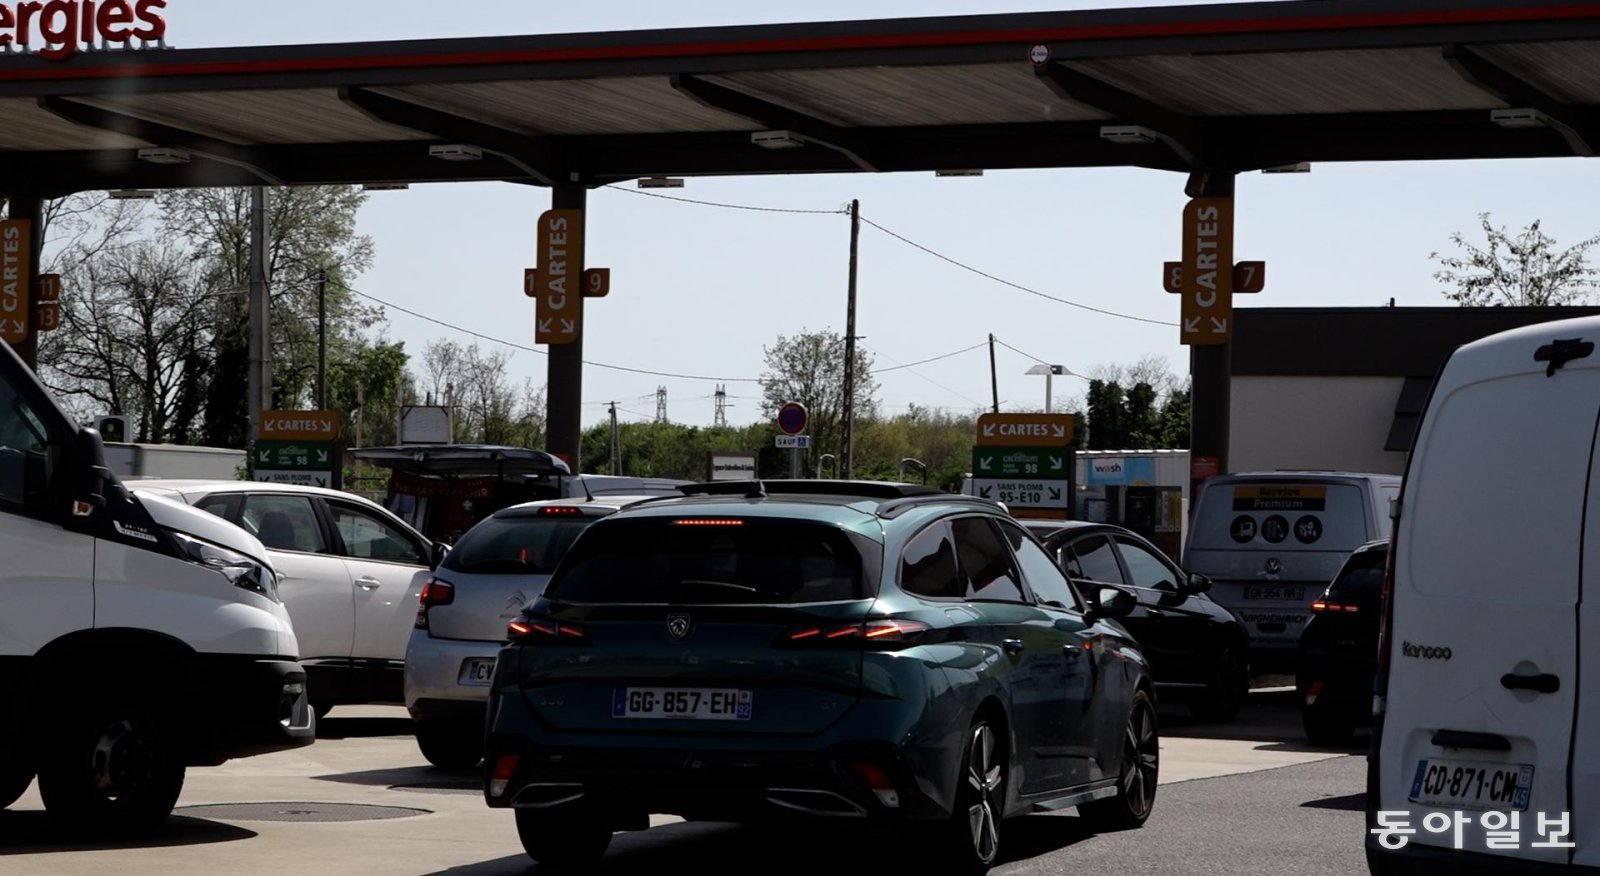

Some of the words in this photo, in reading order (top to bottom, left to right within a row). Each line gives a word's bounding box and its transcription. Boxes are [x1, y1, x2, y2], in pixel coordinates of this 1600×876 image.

[548, 217, 568, 310] CARTES
[1195, 205, 1219, 308] CARTES
[2, 226, 20, 313] CARTES
[1243, 266, 1256, 288] 7
[39, 279, 53, 296] 11
[589, 273, 601, 292] 9
[39, 308, 54, 326] 13
[277, 419, 318, 431] CARTES
[999, 423, 1049, 436] CARTES
[777, 437, 796, 445] SAUF
[296, 456, 308, 465] 98
[1024, 463, 1039, 474] 98
[997, 483, 1016, 491] SANS
[1018, 483, 1044, 491] PLOMB
[1259, 487, 1301, 497] Service
[999, 491, 1041, 503] 95-E10
[1253, 498, 1304, 509] Premium
[629, 691, 737, 714] GG-857-EH
[1424, 765, 1518, 803] CD-871-CM
